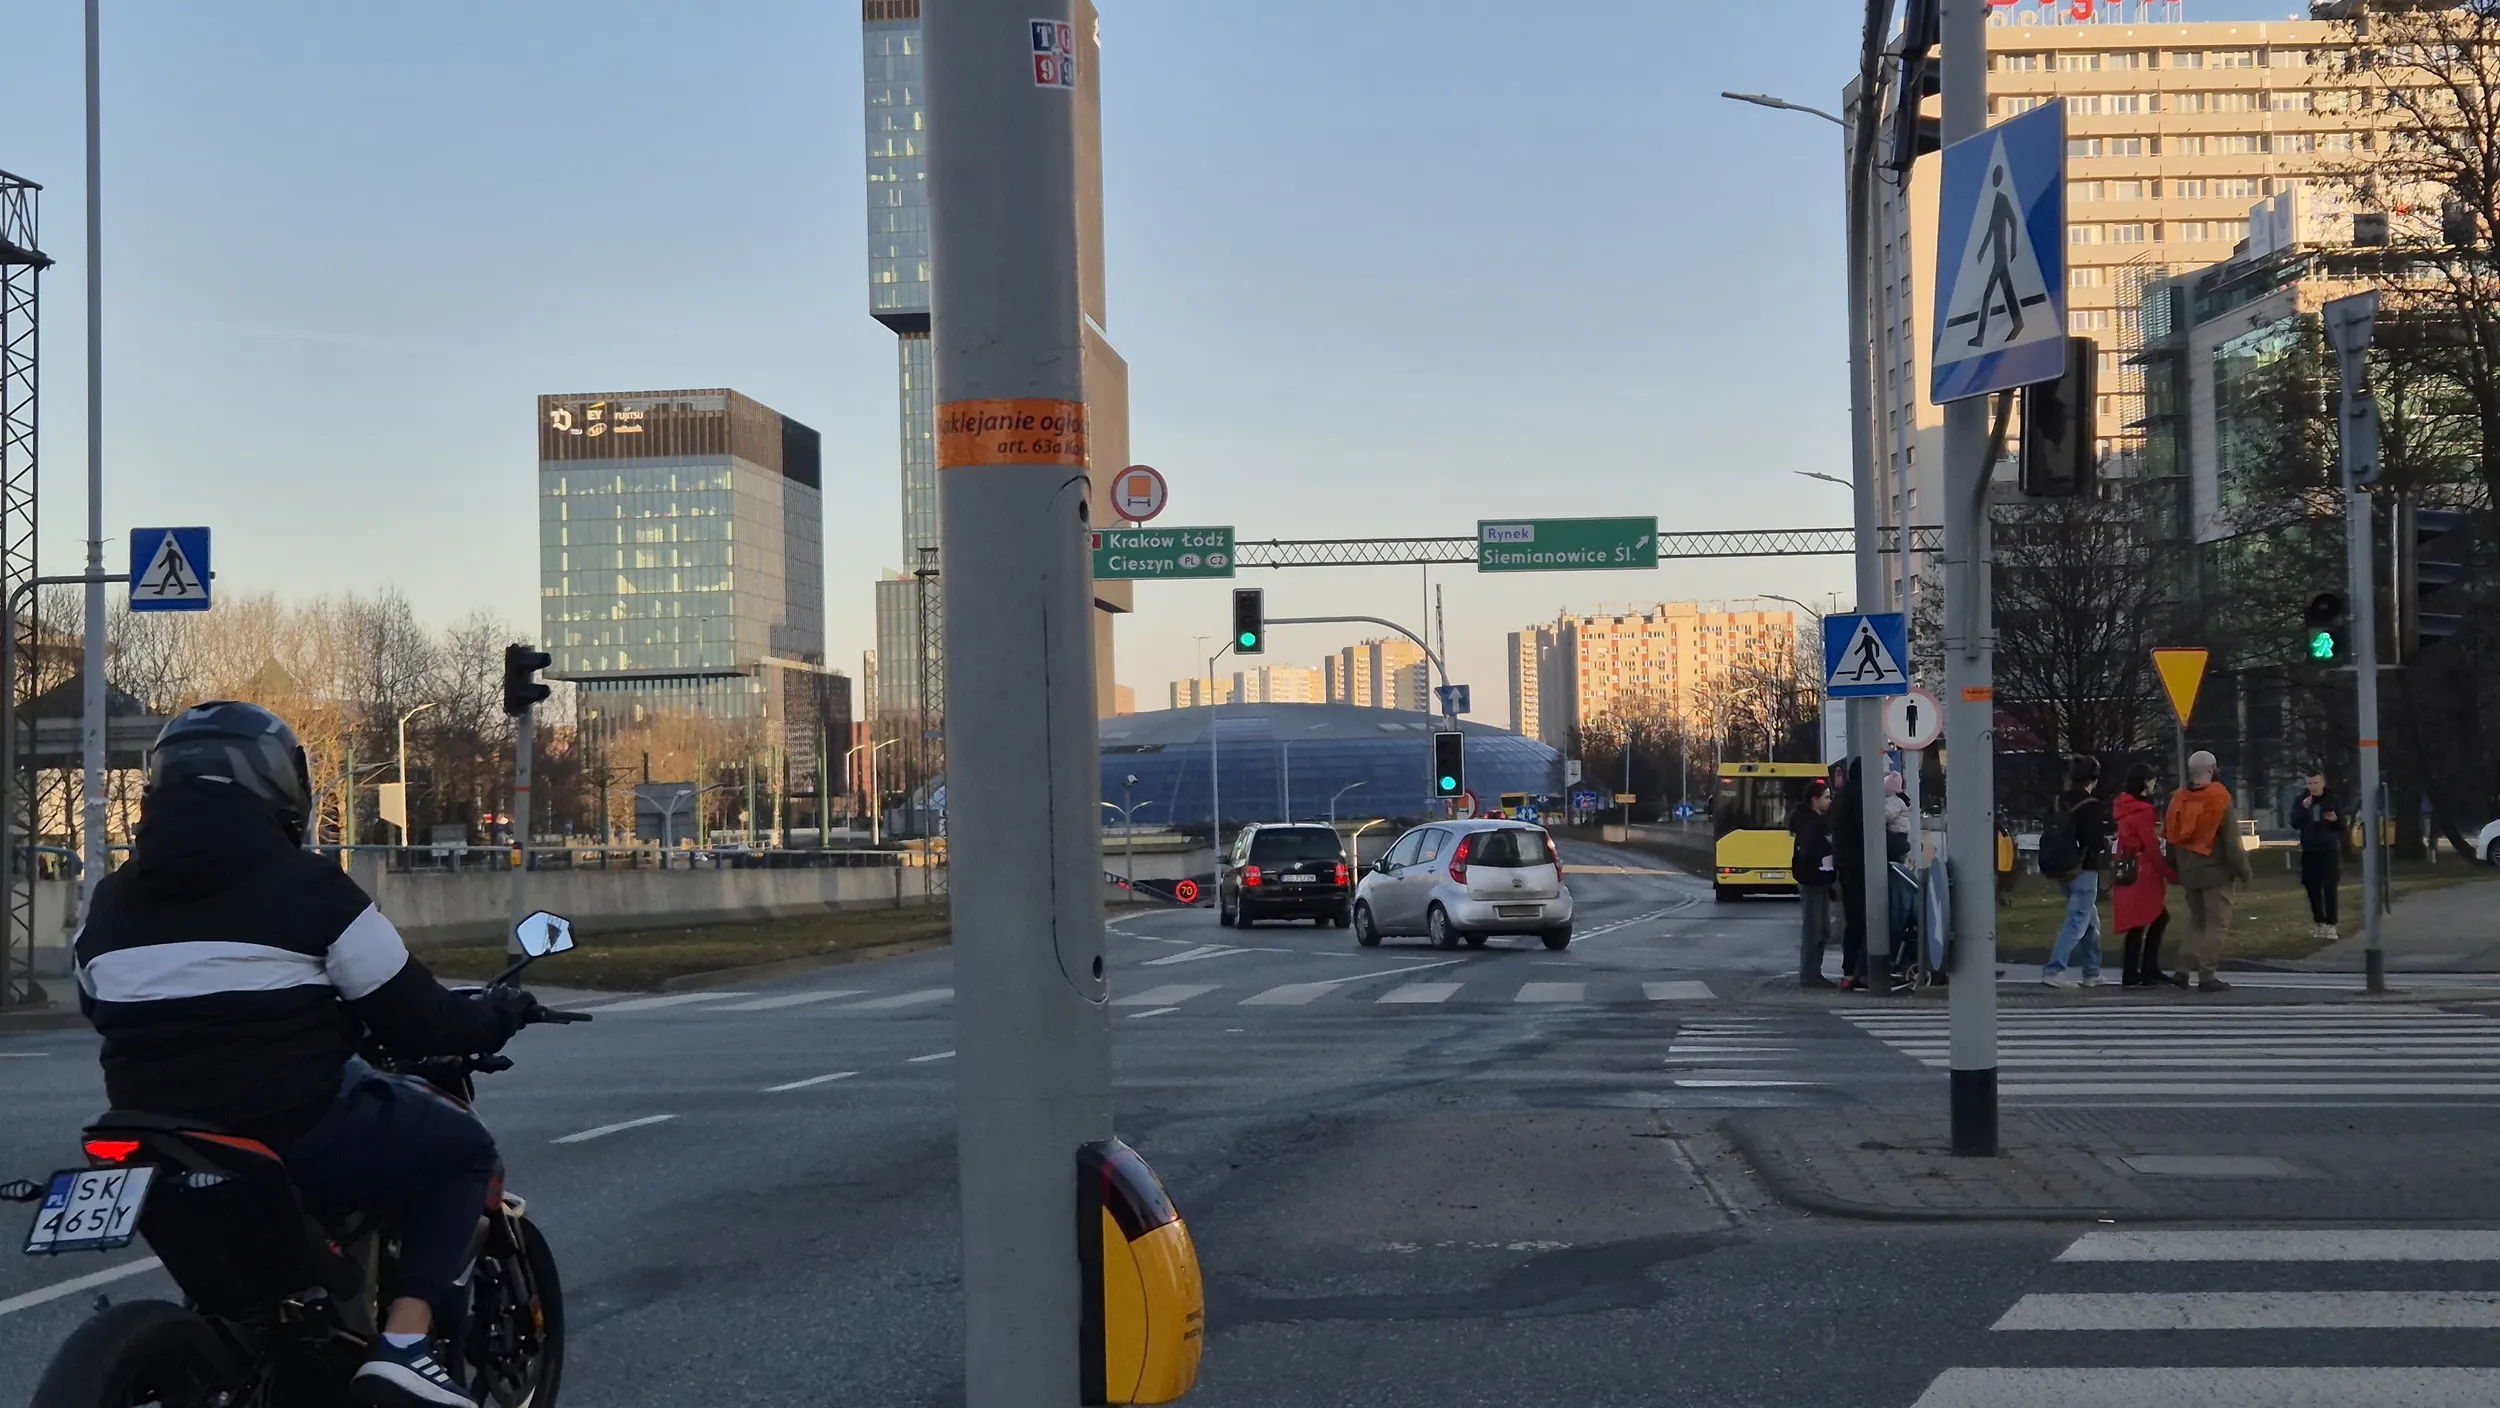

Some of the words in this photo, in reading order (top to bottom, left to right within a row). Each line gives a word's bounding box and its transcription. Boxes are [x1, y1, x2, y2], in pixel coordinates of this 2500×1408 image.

[587, 409, 602, 420] EY
[614, 411, 643, 422] FUJITSU
[935, 411, 1034, 436] aklejanie
[997, 439, 1027, 453] art.
[1033, 439, 1061, 453] 63a
[1110, 533, 1175, 549] Kraków
[1181, 531, 1225, 547] Łódź
[1488, 527, 1529, 541] Rynek
[1484, 549, 1607, 564] Siemianowice
[1615, 542, 1636, 562] Śl.
[1109, 556, 1174, 574] Cieszyn
[1184, 556, 1196, 566] PL
[1209, 556, 1224, 566] CZ
[1181, 886, 1193, 896] 70
[78, 1176, 123, 1201] SK
[45, 1194, 64, 1207] PL
[42, 1206, 132, 1235] 465Y
